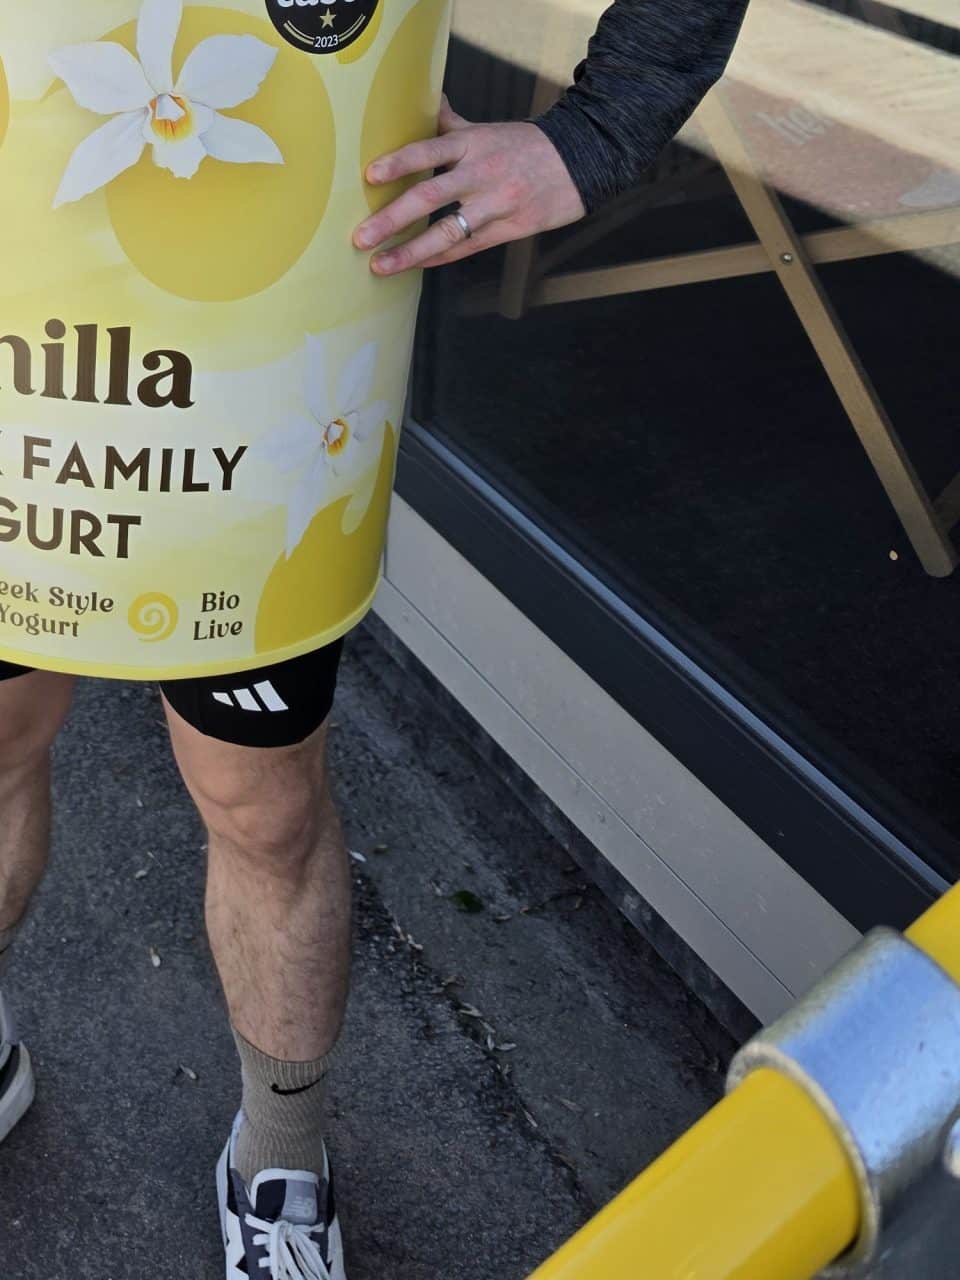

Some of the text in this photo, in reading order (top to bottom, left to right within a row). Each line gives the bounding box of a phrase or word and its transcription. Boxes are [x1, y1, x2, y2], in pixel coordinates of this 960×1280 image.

[314, 34, 339, 48] 2023
[23, 435, 248, 493] FAMILY
[48, 586, 114, 615] Style
[201, 590, 240, 613] Bio
[193, 618, 244, 641] Live
